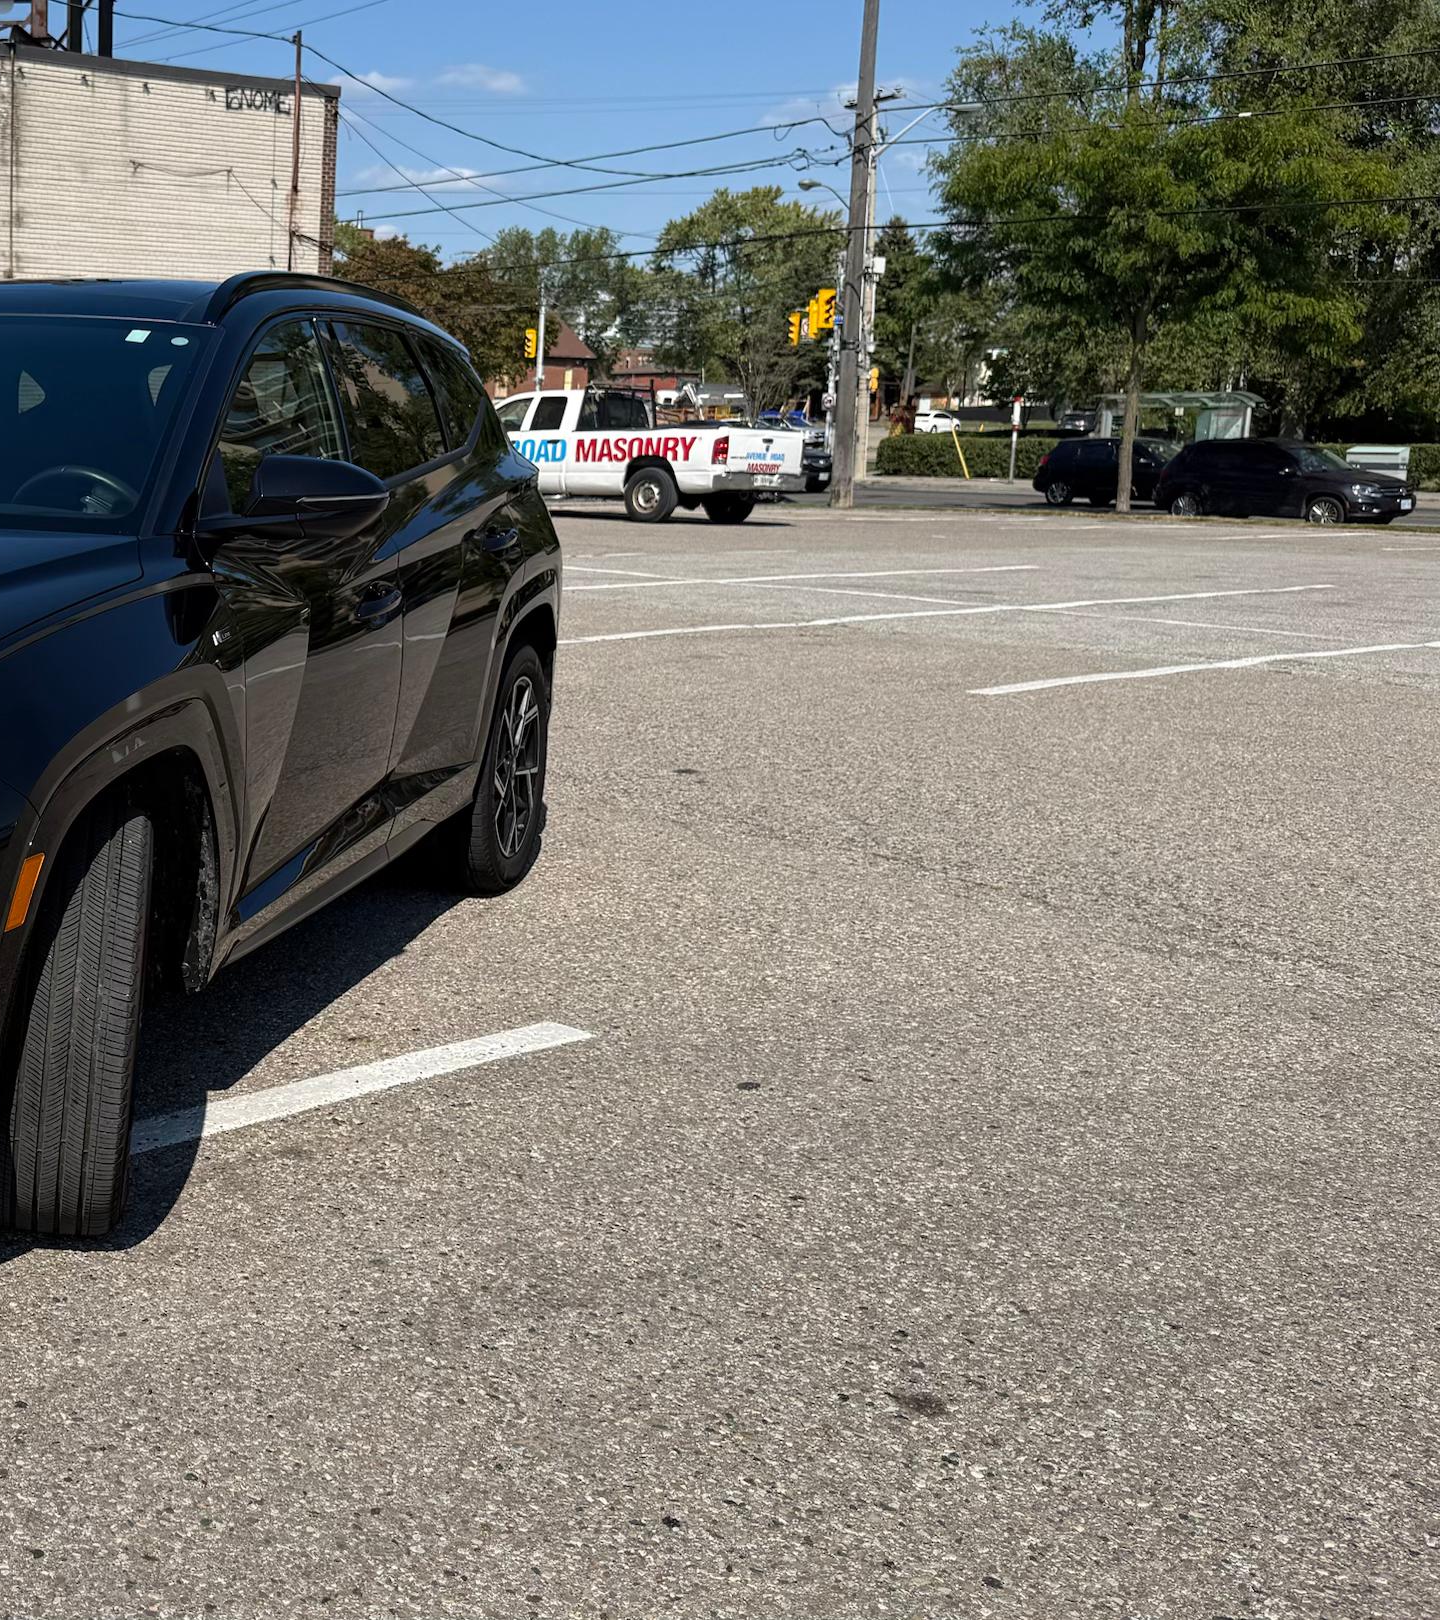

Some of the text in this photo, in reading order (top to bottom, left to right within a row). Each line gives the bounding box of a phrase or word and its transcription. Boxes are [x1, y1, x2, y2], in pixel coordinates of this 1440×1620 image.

[511, 436, 697, 462] OAD MASONRY
[746, 463, 781, 473] MASONRY
